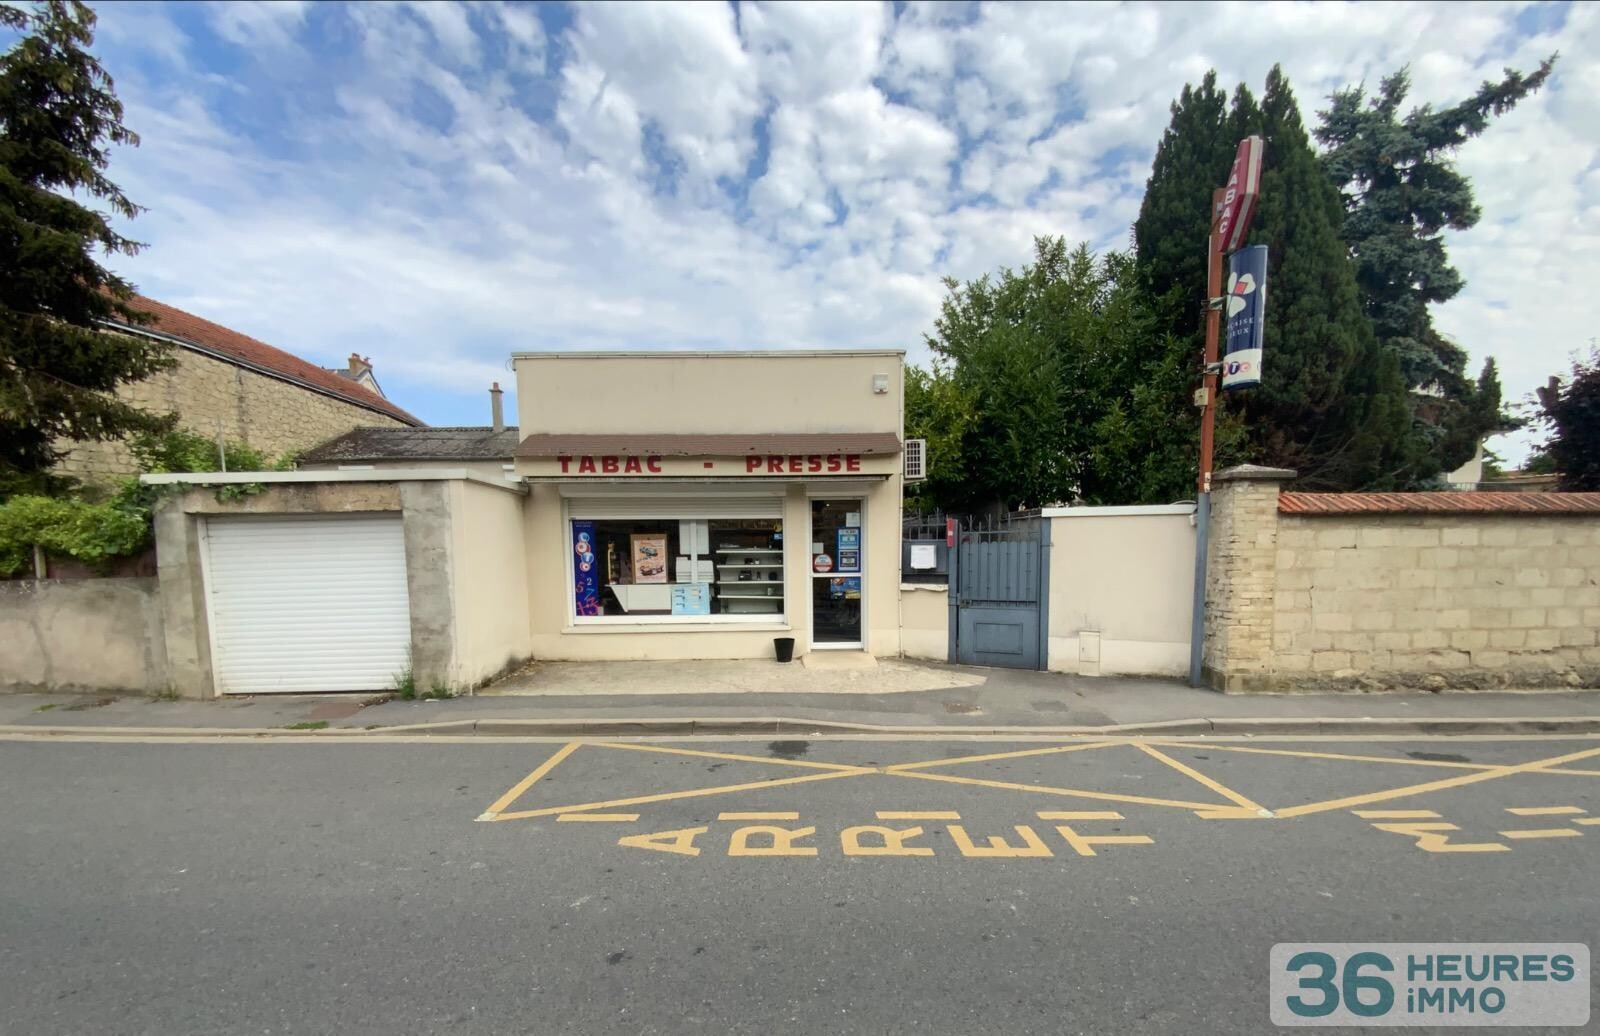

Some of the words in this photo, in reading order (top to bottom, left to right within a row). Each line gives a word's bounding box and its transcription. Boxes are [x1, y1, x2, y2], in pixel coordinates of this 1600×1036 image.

[1219, 157, 1241, 234] TABAC
[557, 456, 662, 473] TABAC
[747, 456, 861, 473] PRESSE
[618, 825, 1155, 858] ARRET
